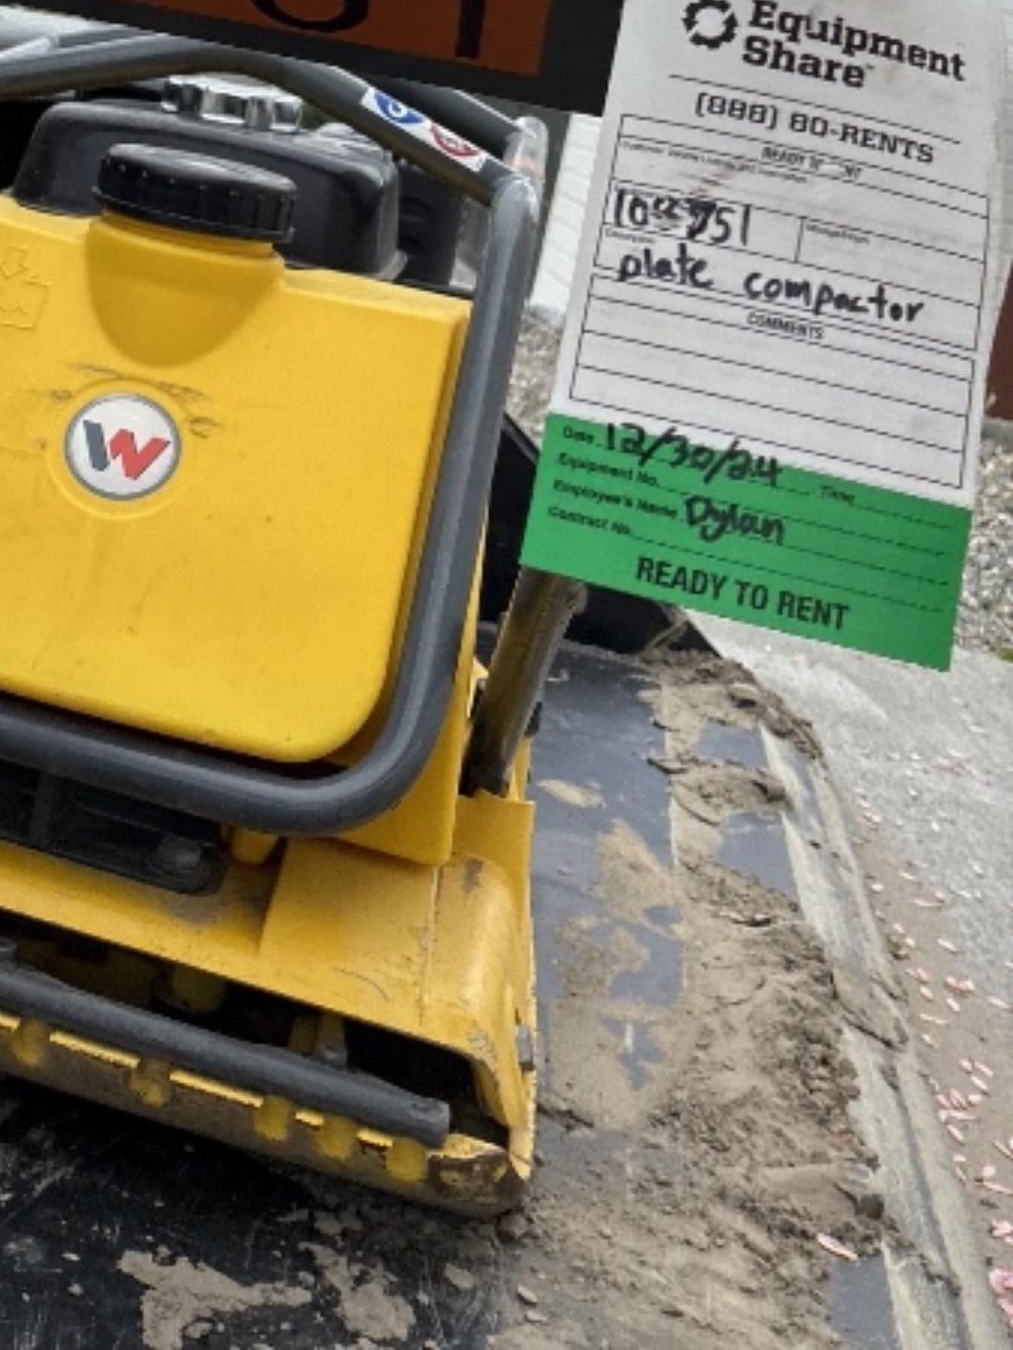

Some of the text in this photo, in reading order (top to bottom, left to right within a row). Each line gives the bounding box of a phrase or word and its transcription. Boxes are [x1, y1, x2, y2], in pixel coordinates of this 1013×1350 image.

[742, 35, 865, 88] Share
[695, 92, 778, 129] (888)
[788, 113, 934, 163] 80-RENTS
[618, 242, 924, 322] plate compactor
[746, 311, 824, 341] COMMENTS
[686, 495, 785, 546] Dylan
[636, 556, 849, 630] READY TO RENT
